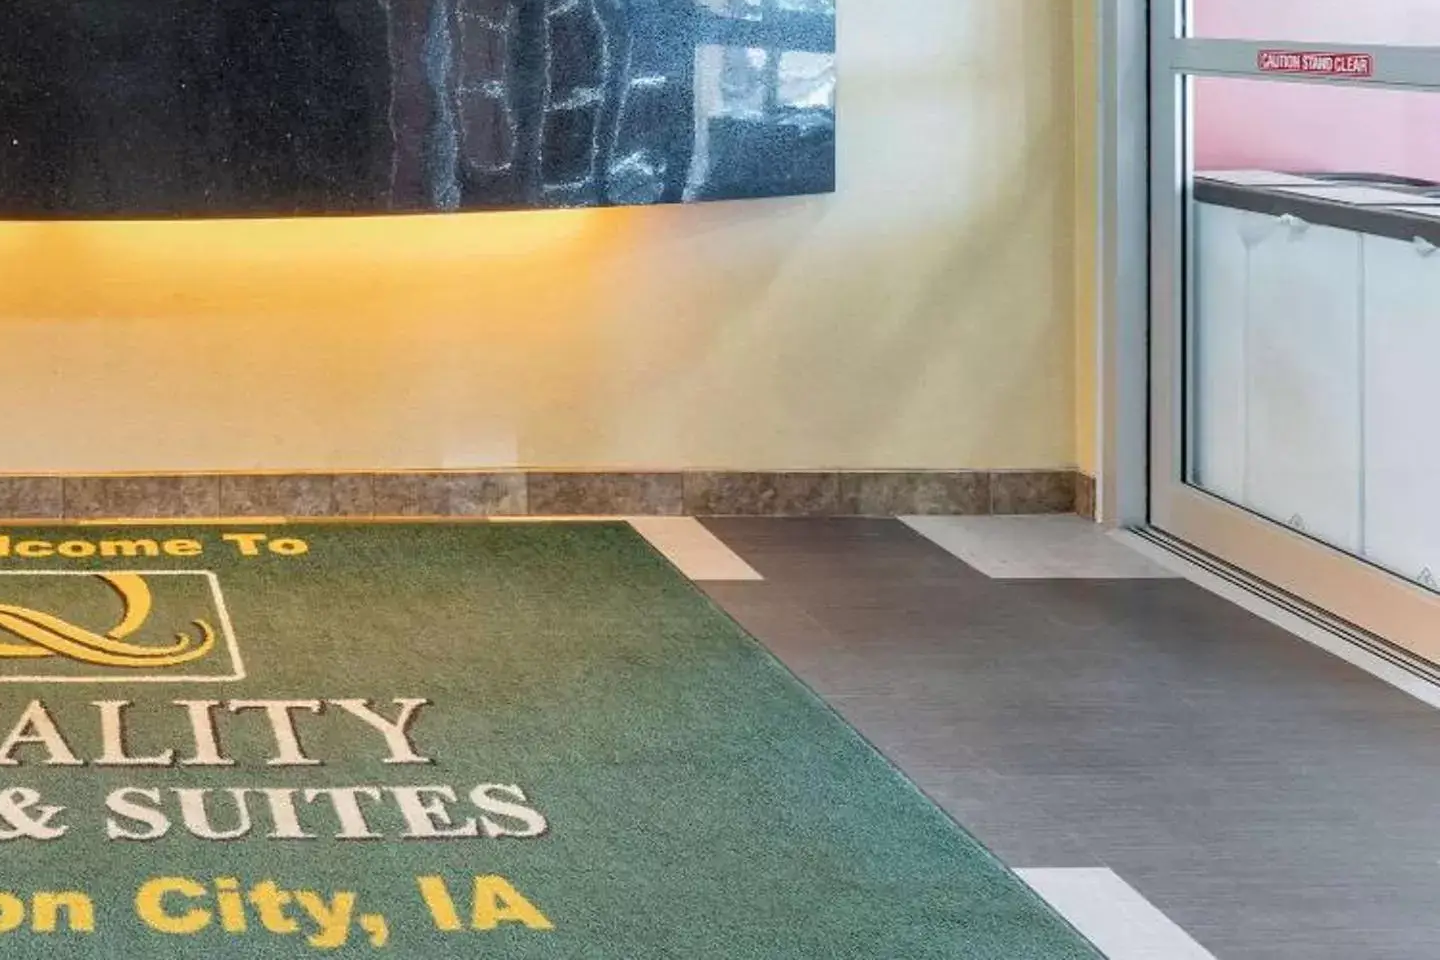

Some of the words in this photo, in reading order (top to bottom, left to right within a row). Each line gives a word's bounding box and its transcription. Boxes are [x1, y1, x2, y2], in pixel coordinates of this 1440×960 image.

[1261, 53, 1301, 69] CAUTION
[1302, 54, 1333, 71] STAND
[1334, 56, 1369, 73] CLEAR
[224, 532, 309, 558] To
[105, 781, 550, 841] SUITES
[134, 875, 390, 950] City,
[417, 874, 553, 932] IA
